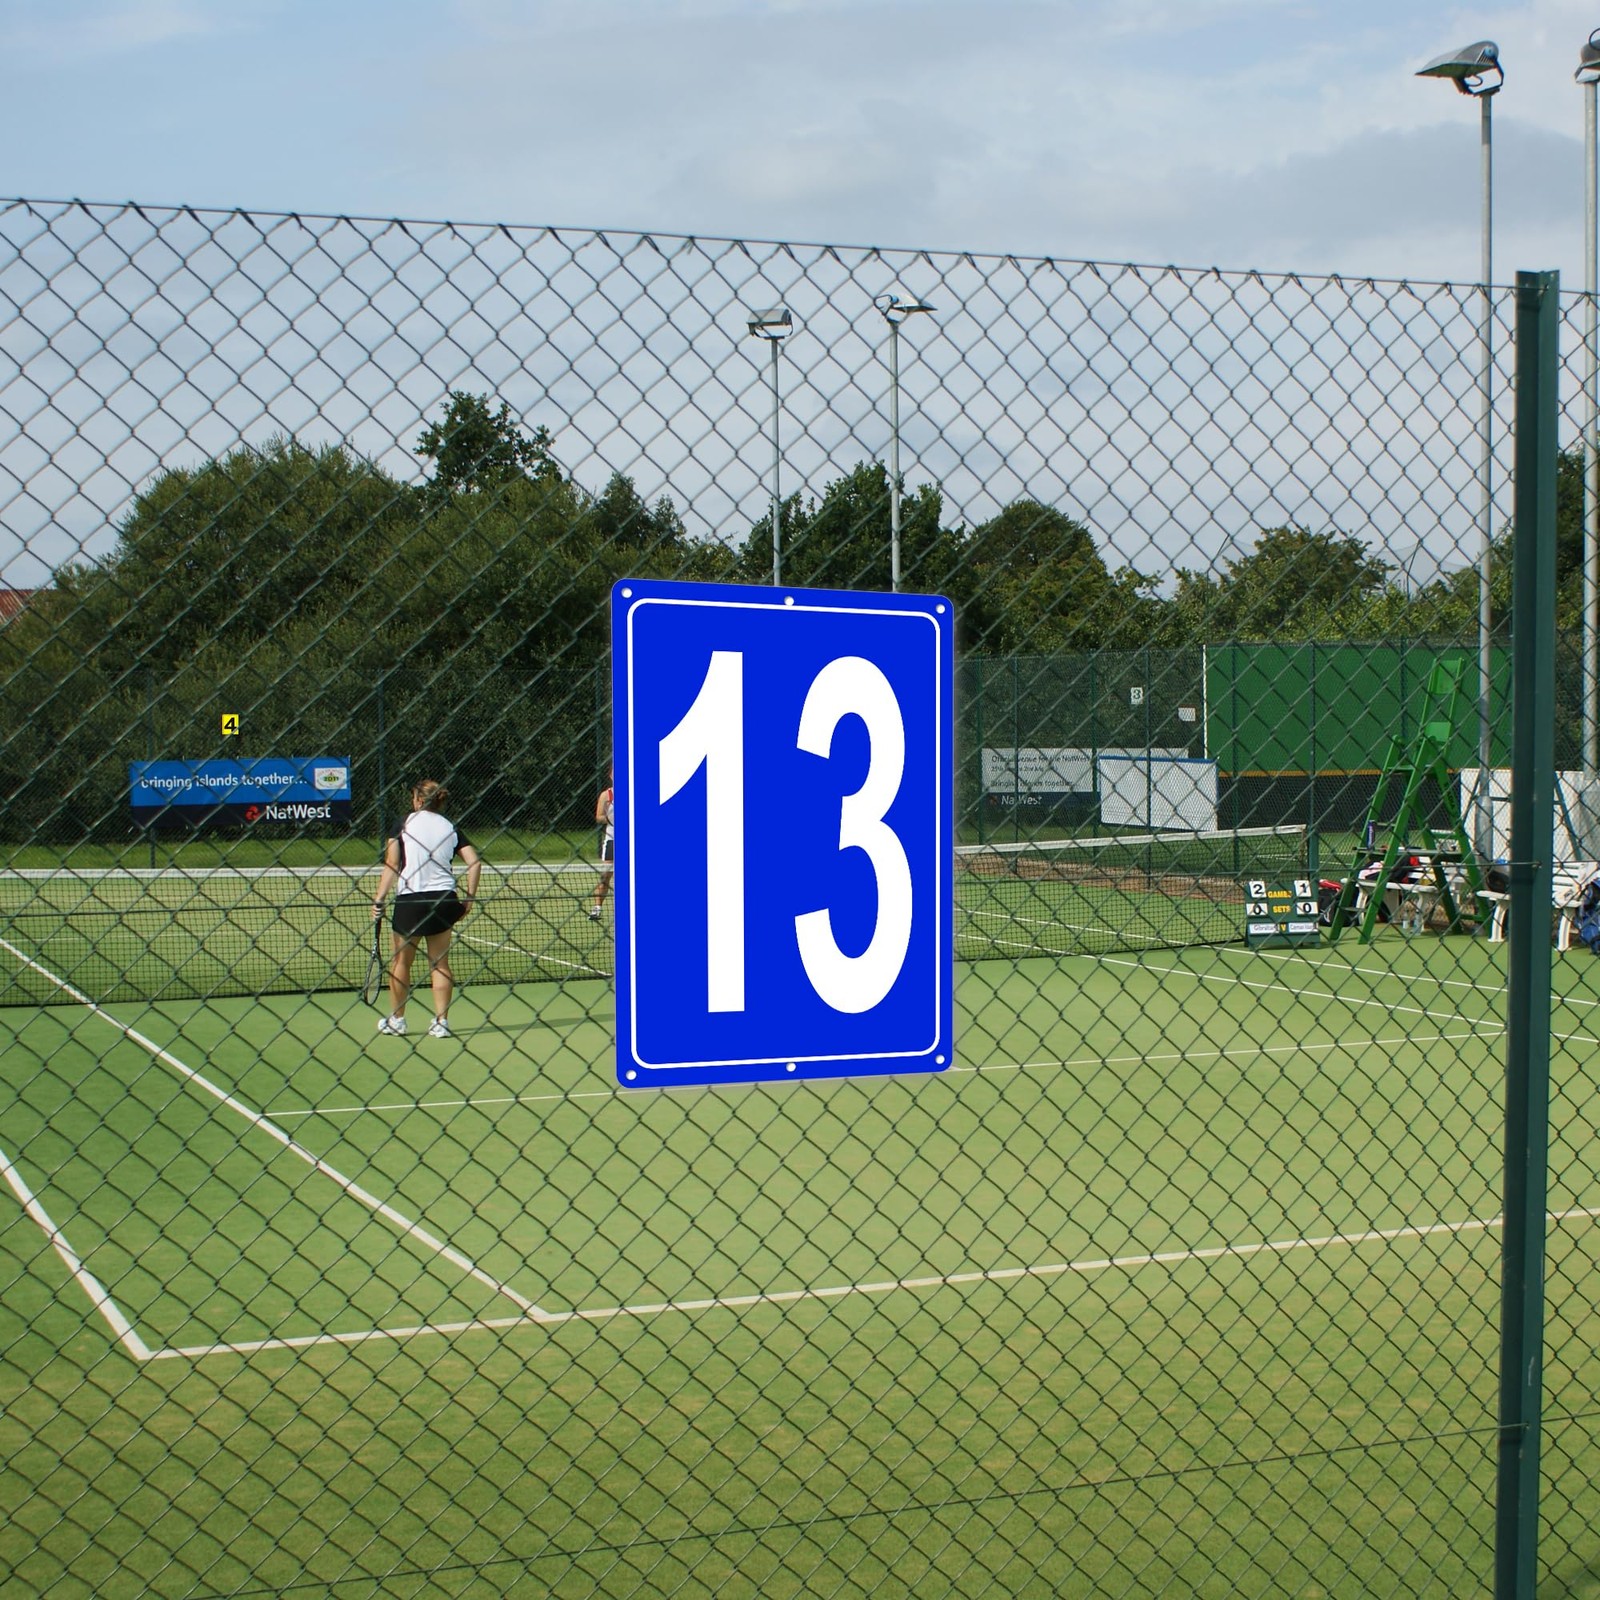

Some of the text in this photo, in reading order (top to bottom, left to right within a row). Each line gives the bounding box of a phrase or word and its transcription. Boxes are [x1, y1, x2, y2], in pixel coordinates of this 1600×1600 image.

[1133, 689, 1141, 699] 3
[224, 717, 237, 732] 4
[196, 773, 238, 787] islands
[1001, 795, 1043, 805] NaWest
[266, 804, 331, 820] NatWest
[659, 650, 913, 1014] 13
[1253, 883, 1264, 895] 2
[1300, 883, 1308, 894] 1
[1253, 902, 1312, 915] 0 SETS 0
